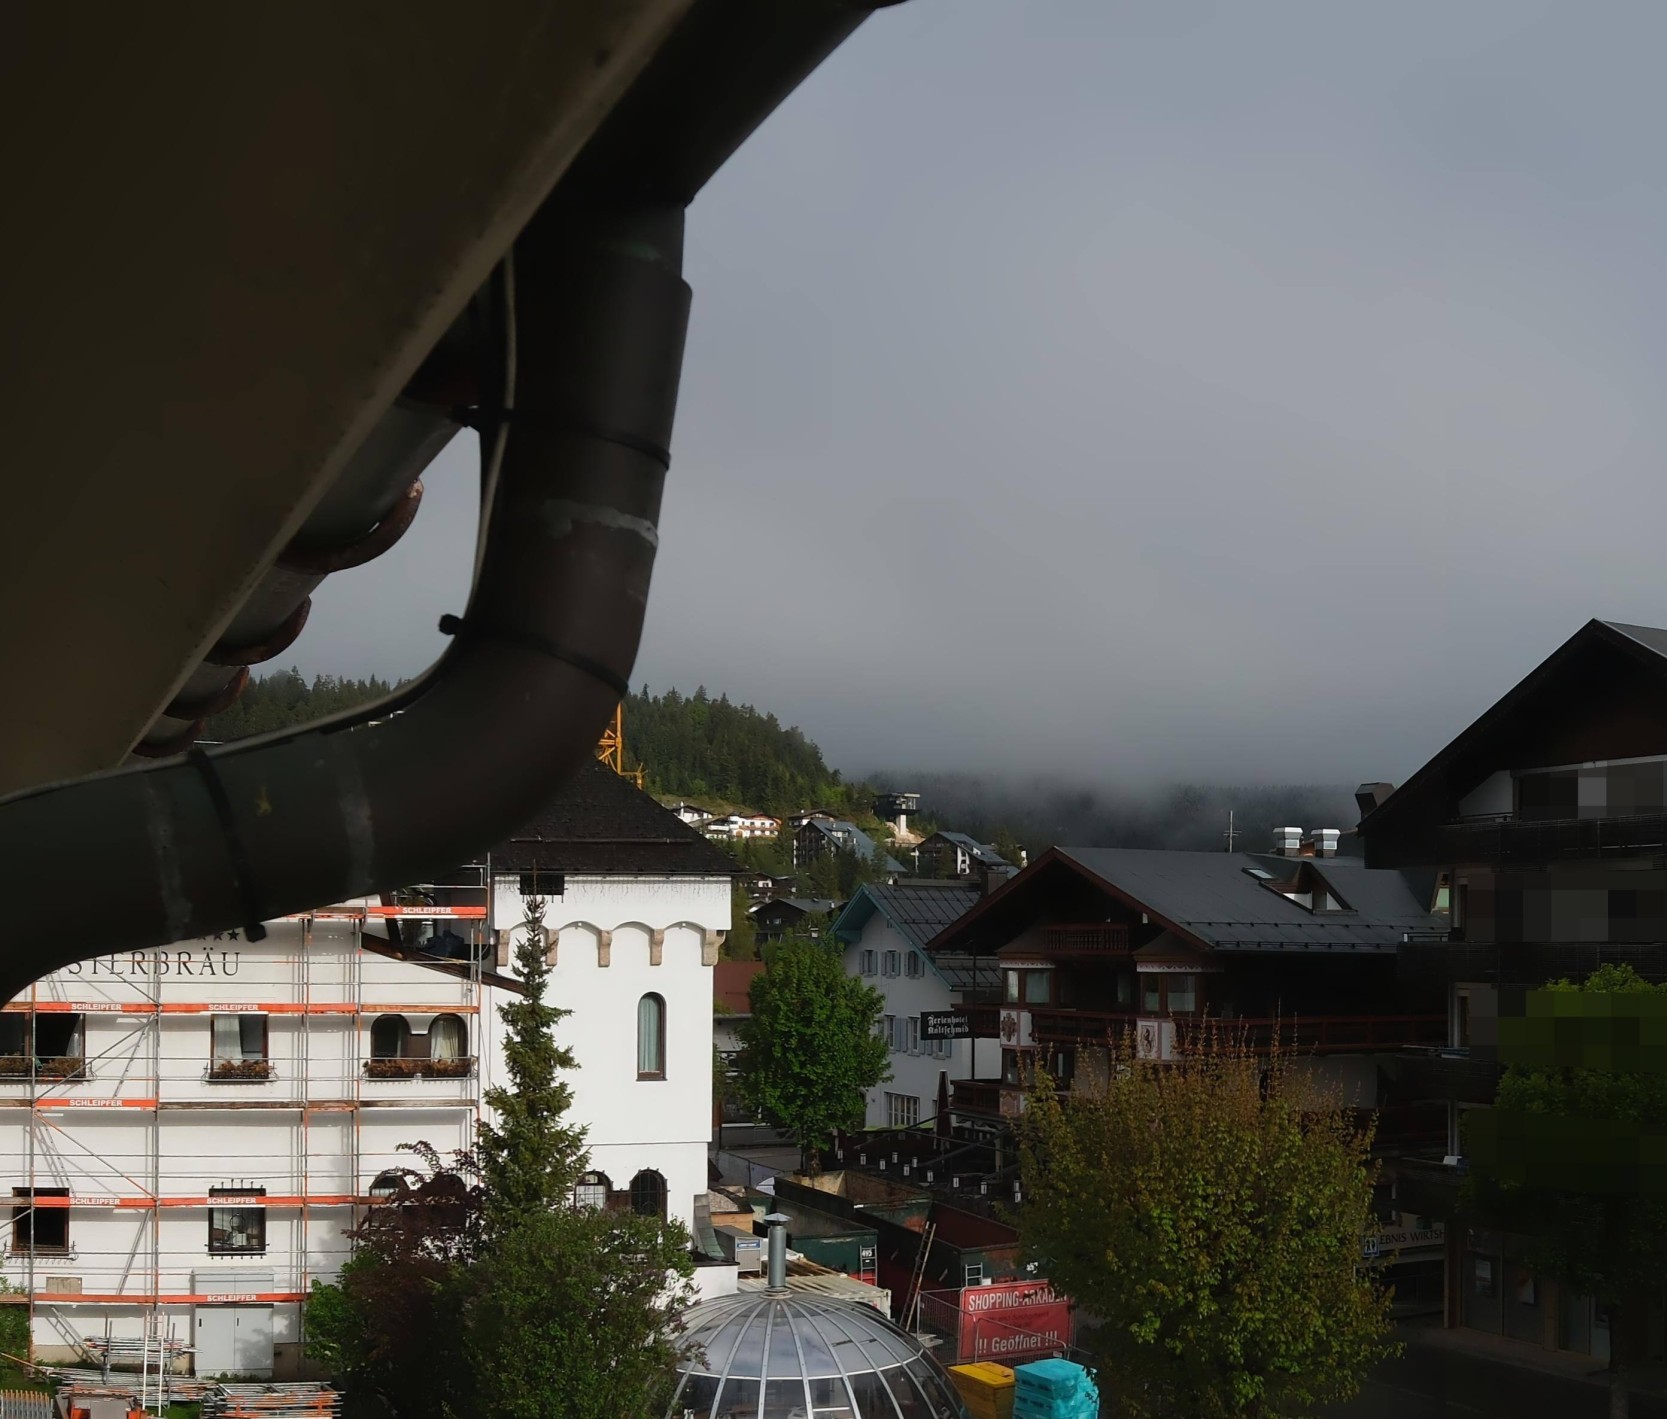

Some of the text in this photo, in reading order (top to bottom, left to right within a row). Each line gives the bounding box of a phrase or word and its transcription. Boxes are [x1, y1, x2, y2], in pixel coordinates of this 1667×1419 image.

[402, 906, 452, 915] SCHLEIPFER
[71, 1003, 122, 1012] SCHLEIPFER
[208, 1003, 259, 1012] SCHLEIPFER
[69, 1099, 123, 1107] SCHLEIPFER
[69, 1197, 121, 1206] SCHLEIPFER
[206, 1196, 257, 1205] SCHLEIPFER
[206, 1293, 257, 1302] SCHLEIPFER
[991, 1332, 1042, 1352] Geöffnet
